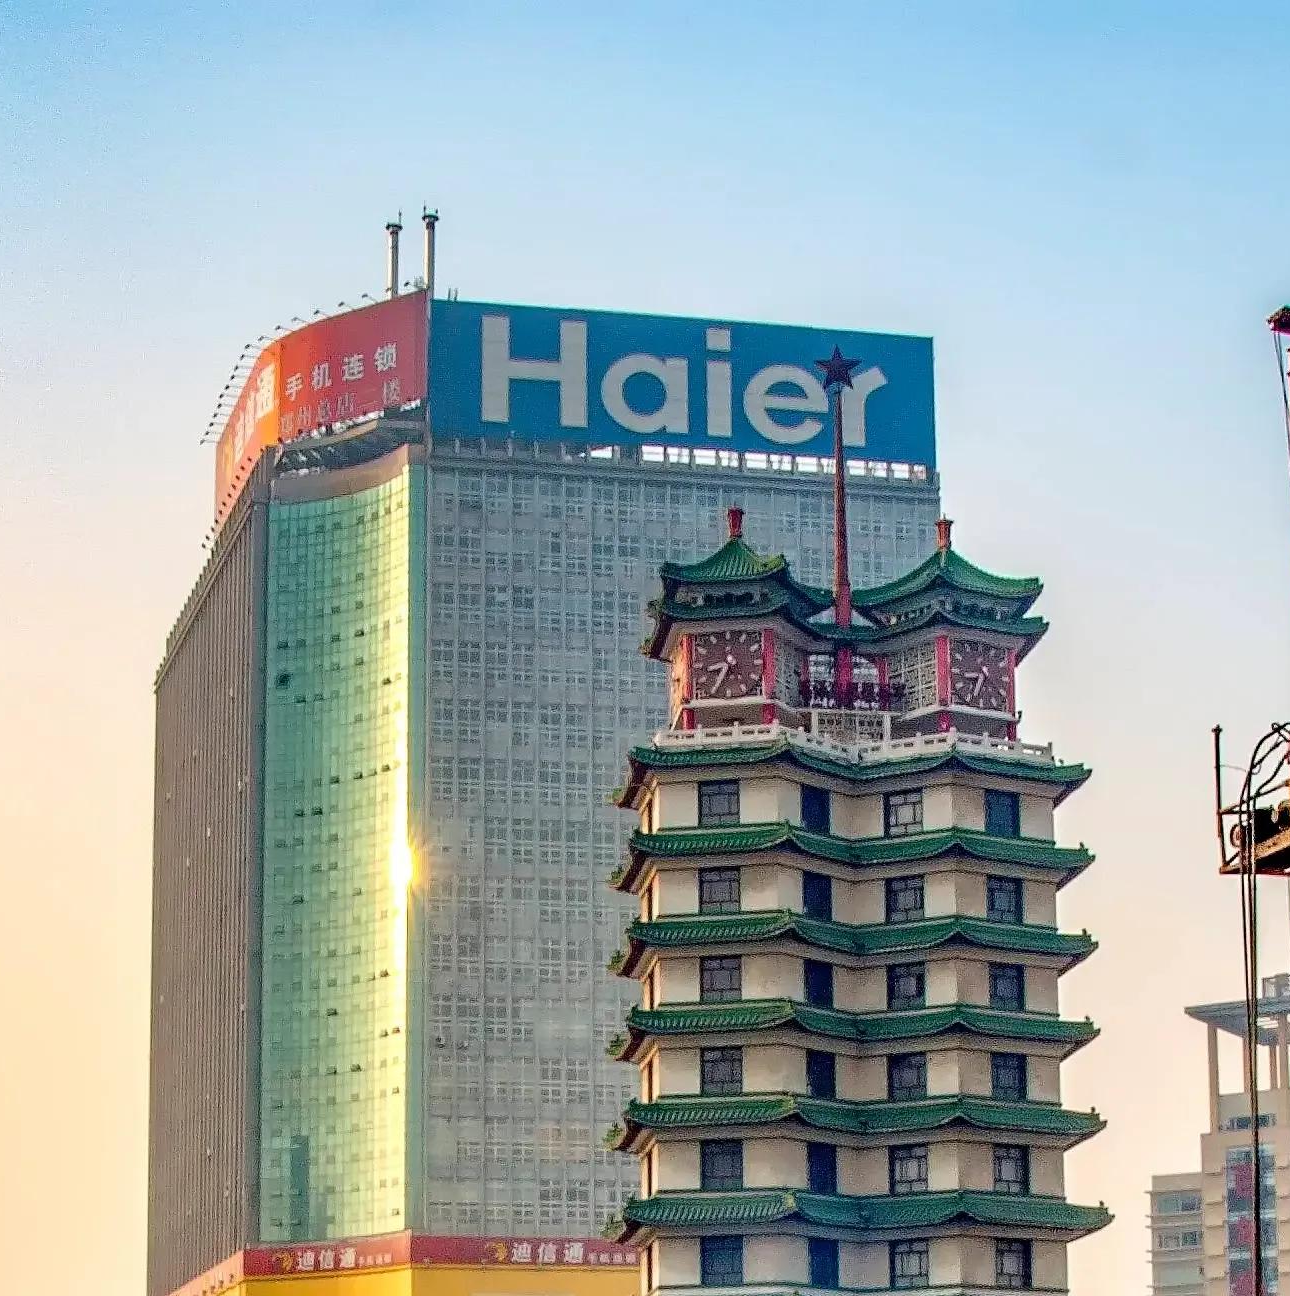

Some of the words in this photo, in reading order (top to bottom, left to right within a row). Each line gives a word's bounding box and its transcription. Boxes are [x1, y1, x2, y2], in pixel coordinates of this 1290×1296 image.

[285, 342, 398, 402] 手机连锁
[481, 313, 887, 447] Haier
